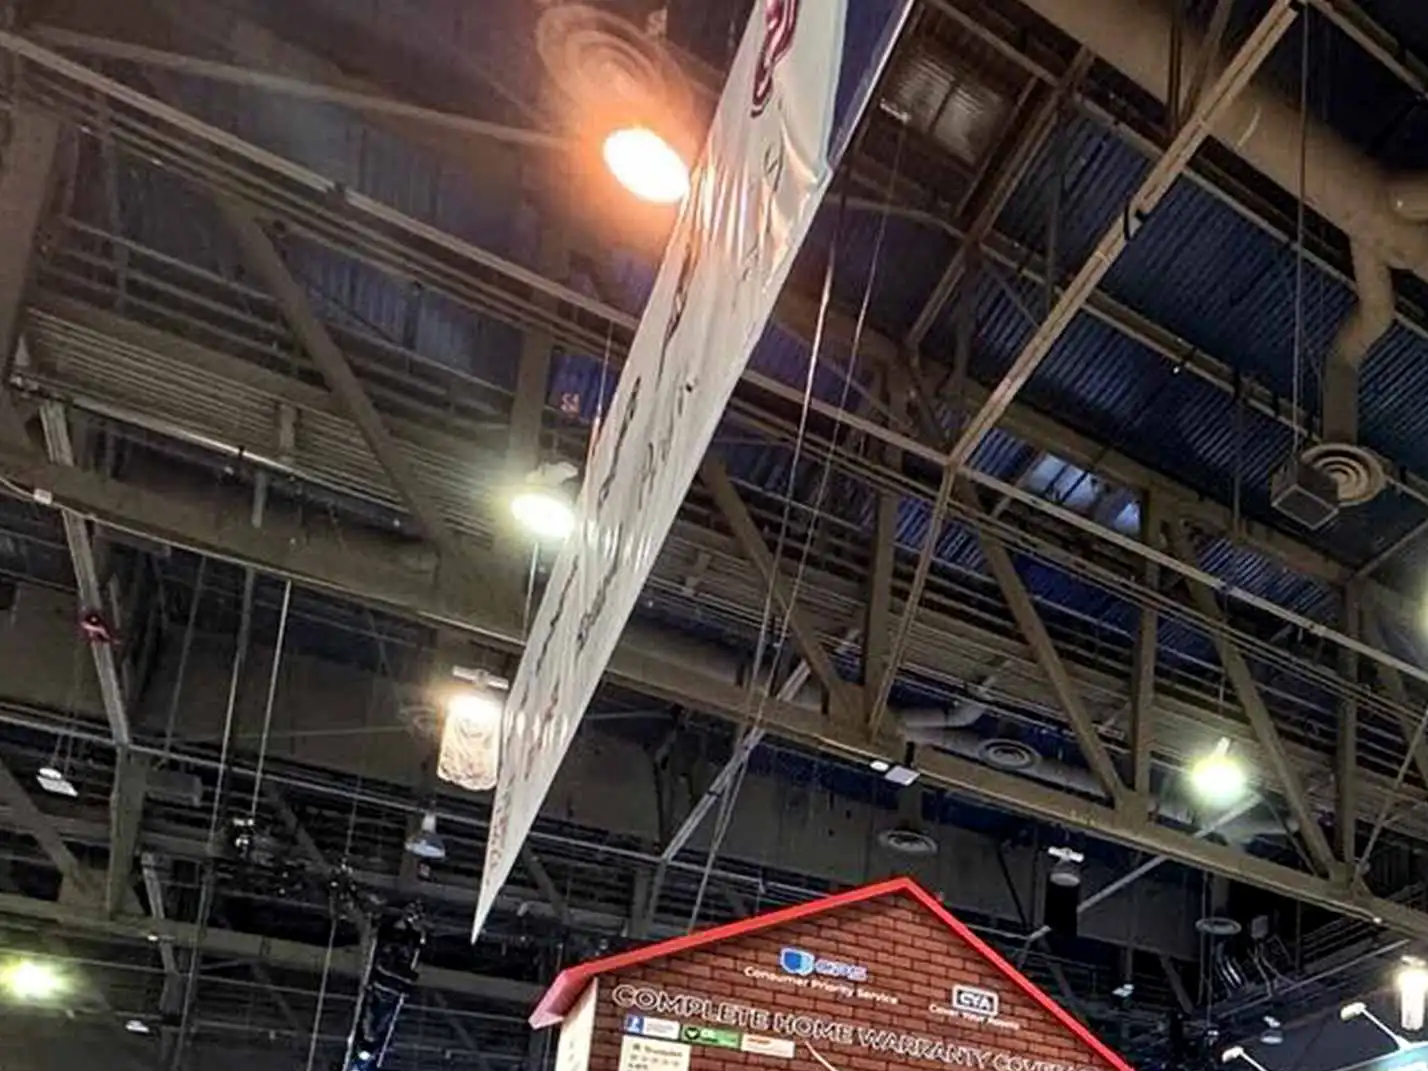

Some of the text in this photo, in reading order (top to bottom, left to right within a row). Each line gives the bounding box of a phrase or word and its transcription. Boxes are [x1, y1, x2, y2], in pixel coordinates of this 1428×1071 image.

[810, 979, 855, 998] Priority
[856, 987, 899, 1005] Service
[612, 983, 770, 1032] COMPLETE
[772, 1011, 853, 1045] HOME
[856, 1027, 993, 1070] WARRANTY
